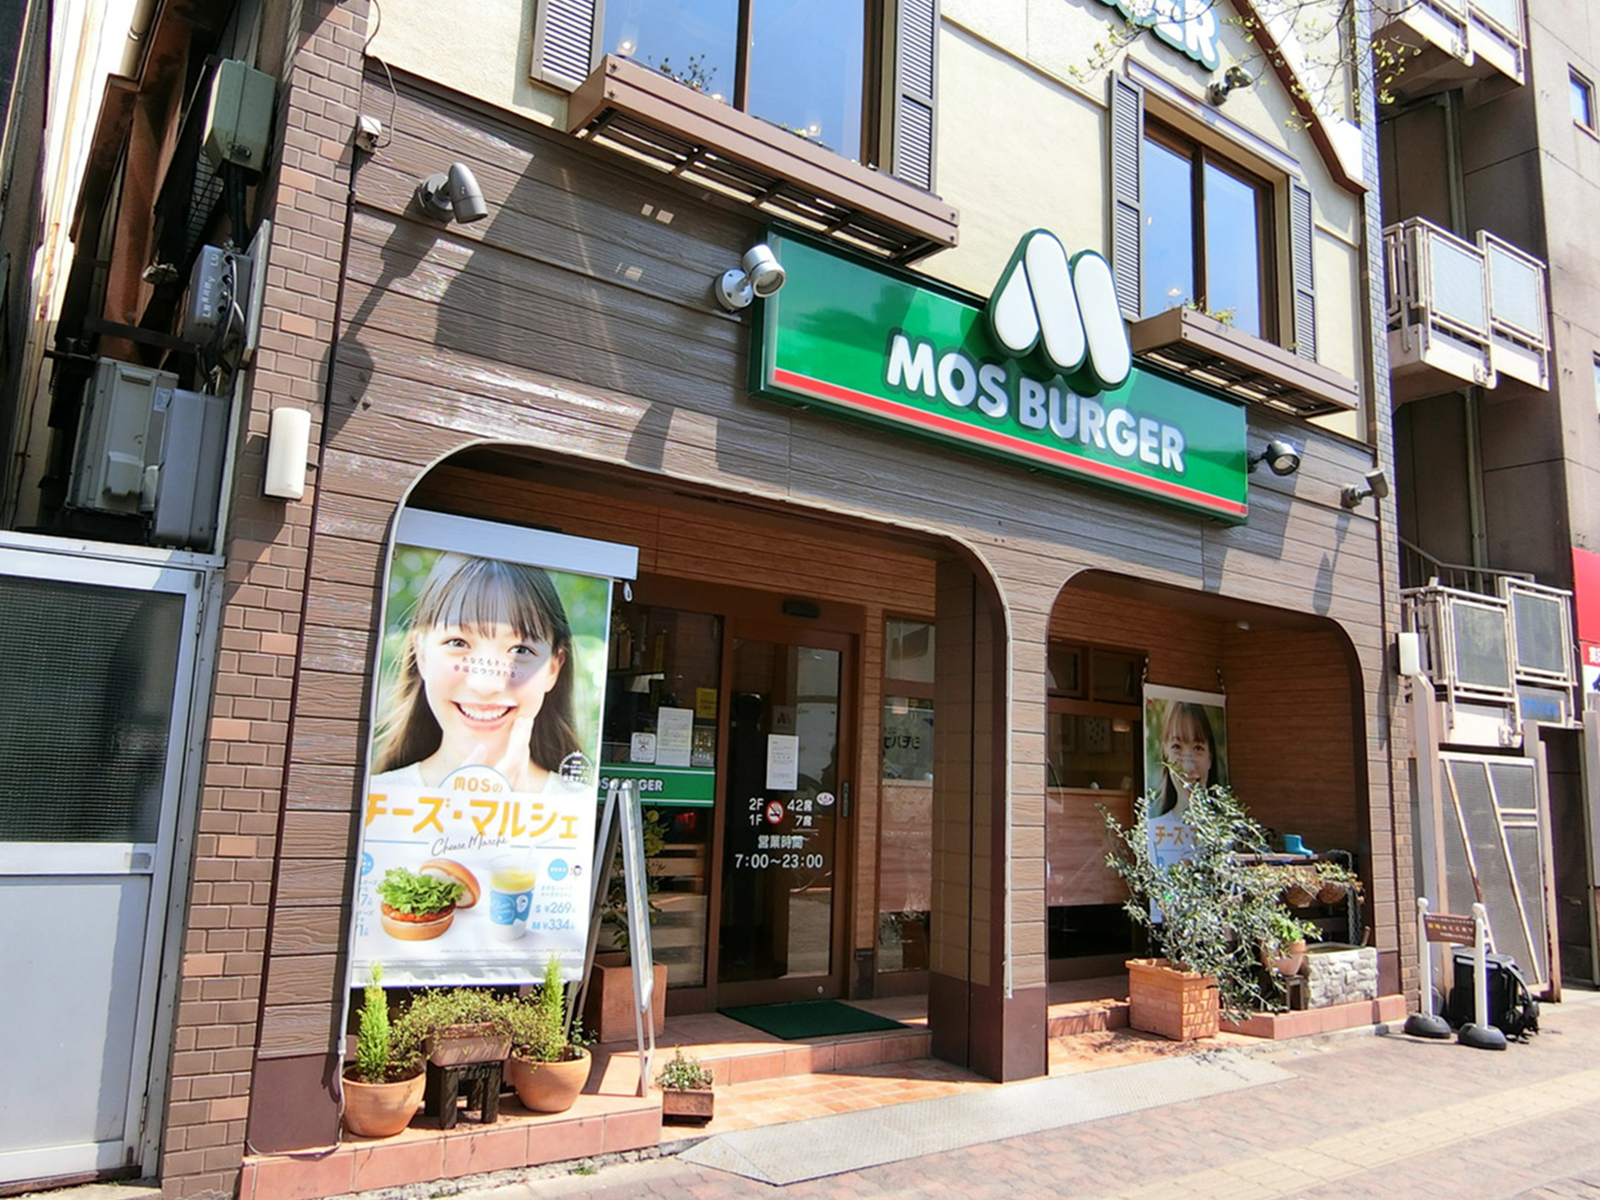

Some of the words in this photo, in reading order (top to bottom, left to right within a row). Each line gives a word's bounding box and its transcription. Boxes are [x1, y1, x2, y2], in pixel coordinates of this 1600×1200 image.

[887, 334, 1009, 418] MOS
[1019, 377, 1185, 473] BURGER
[748, 798, 764, 811] 2F
[748, 814, 763, 826] 1F
[757, 835, 804, 849] 営業時間
